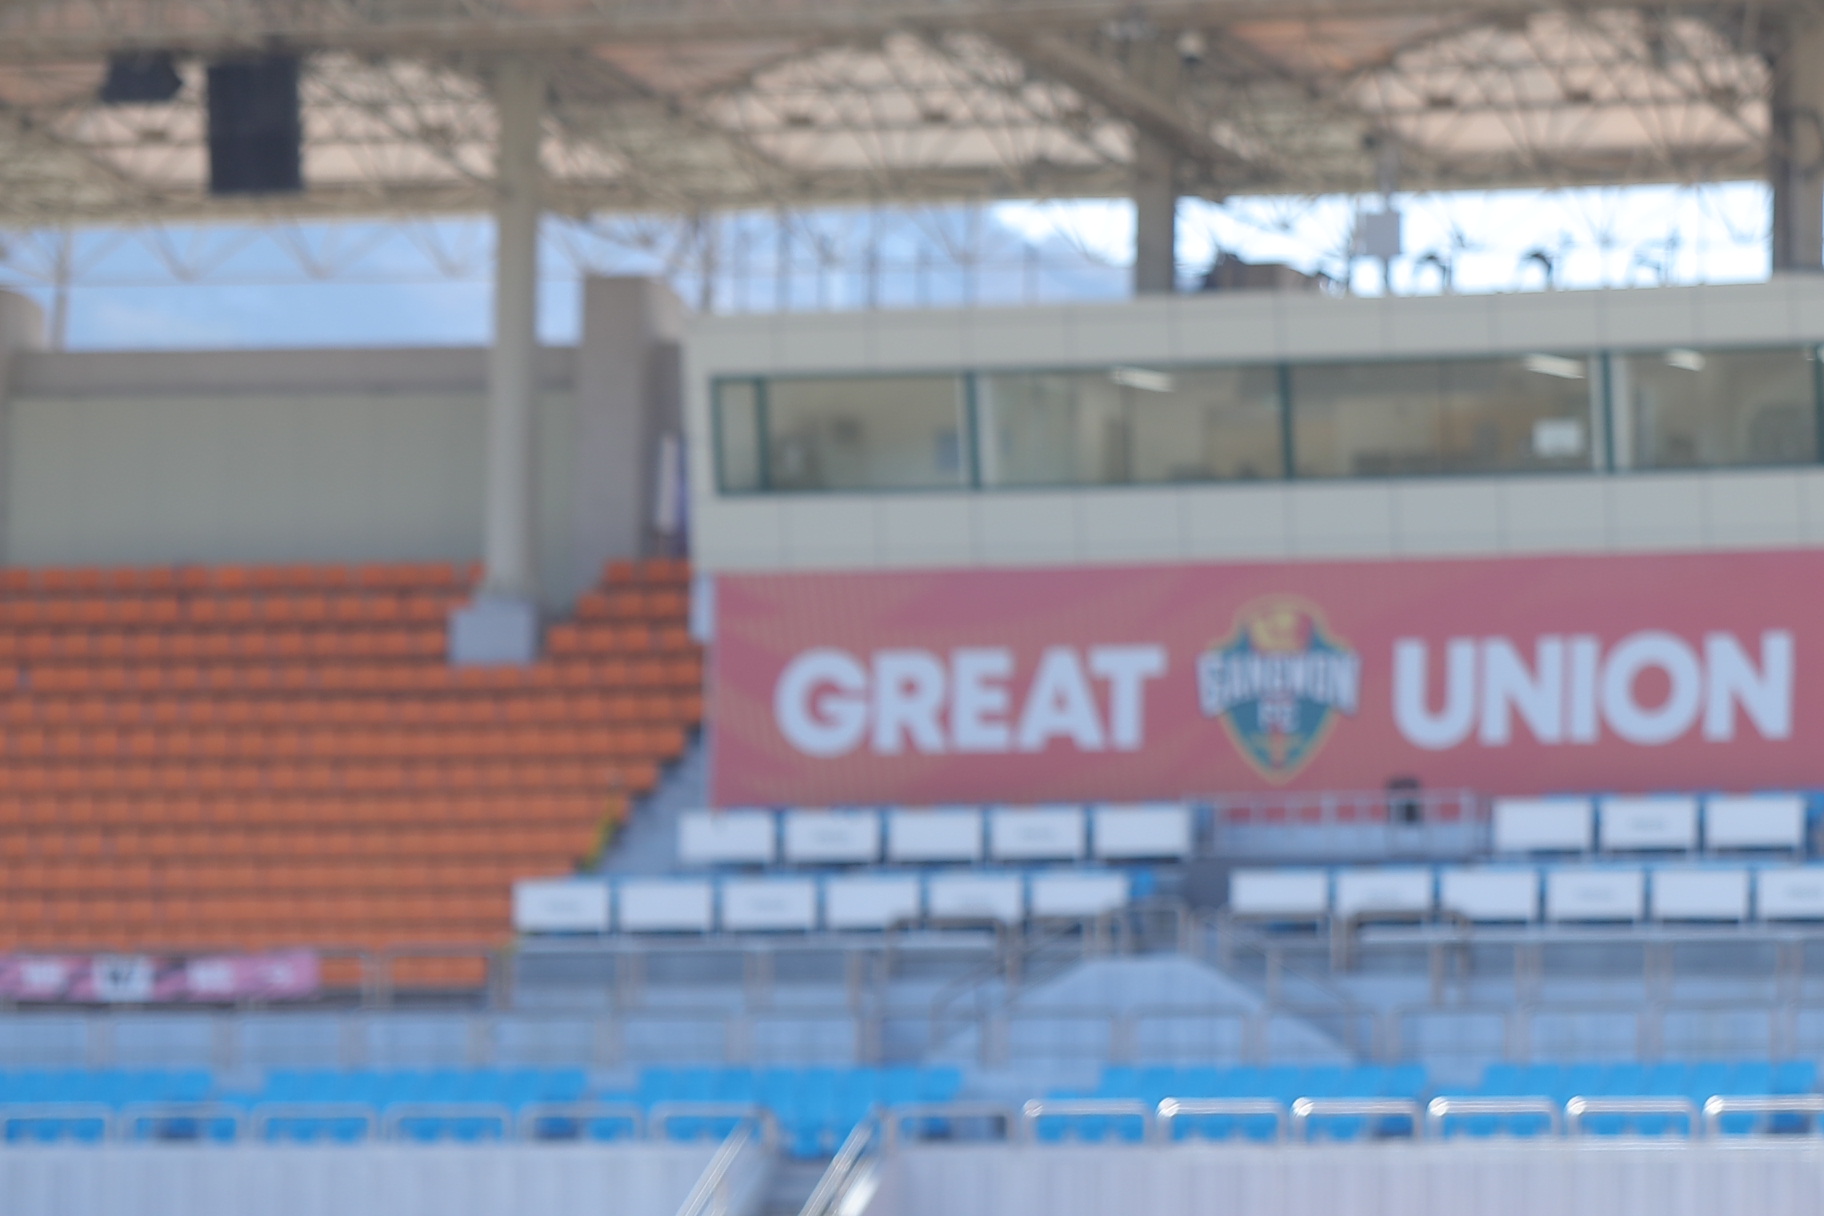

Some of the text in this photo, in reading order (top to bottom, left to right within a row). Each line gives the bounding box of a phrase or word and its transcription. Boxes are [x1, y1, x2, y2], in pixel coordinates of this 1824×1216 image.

[774, 629, 1794, 757] GREAT UNION
[1196, 651, 1361, 718] GANGWON
